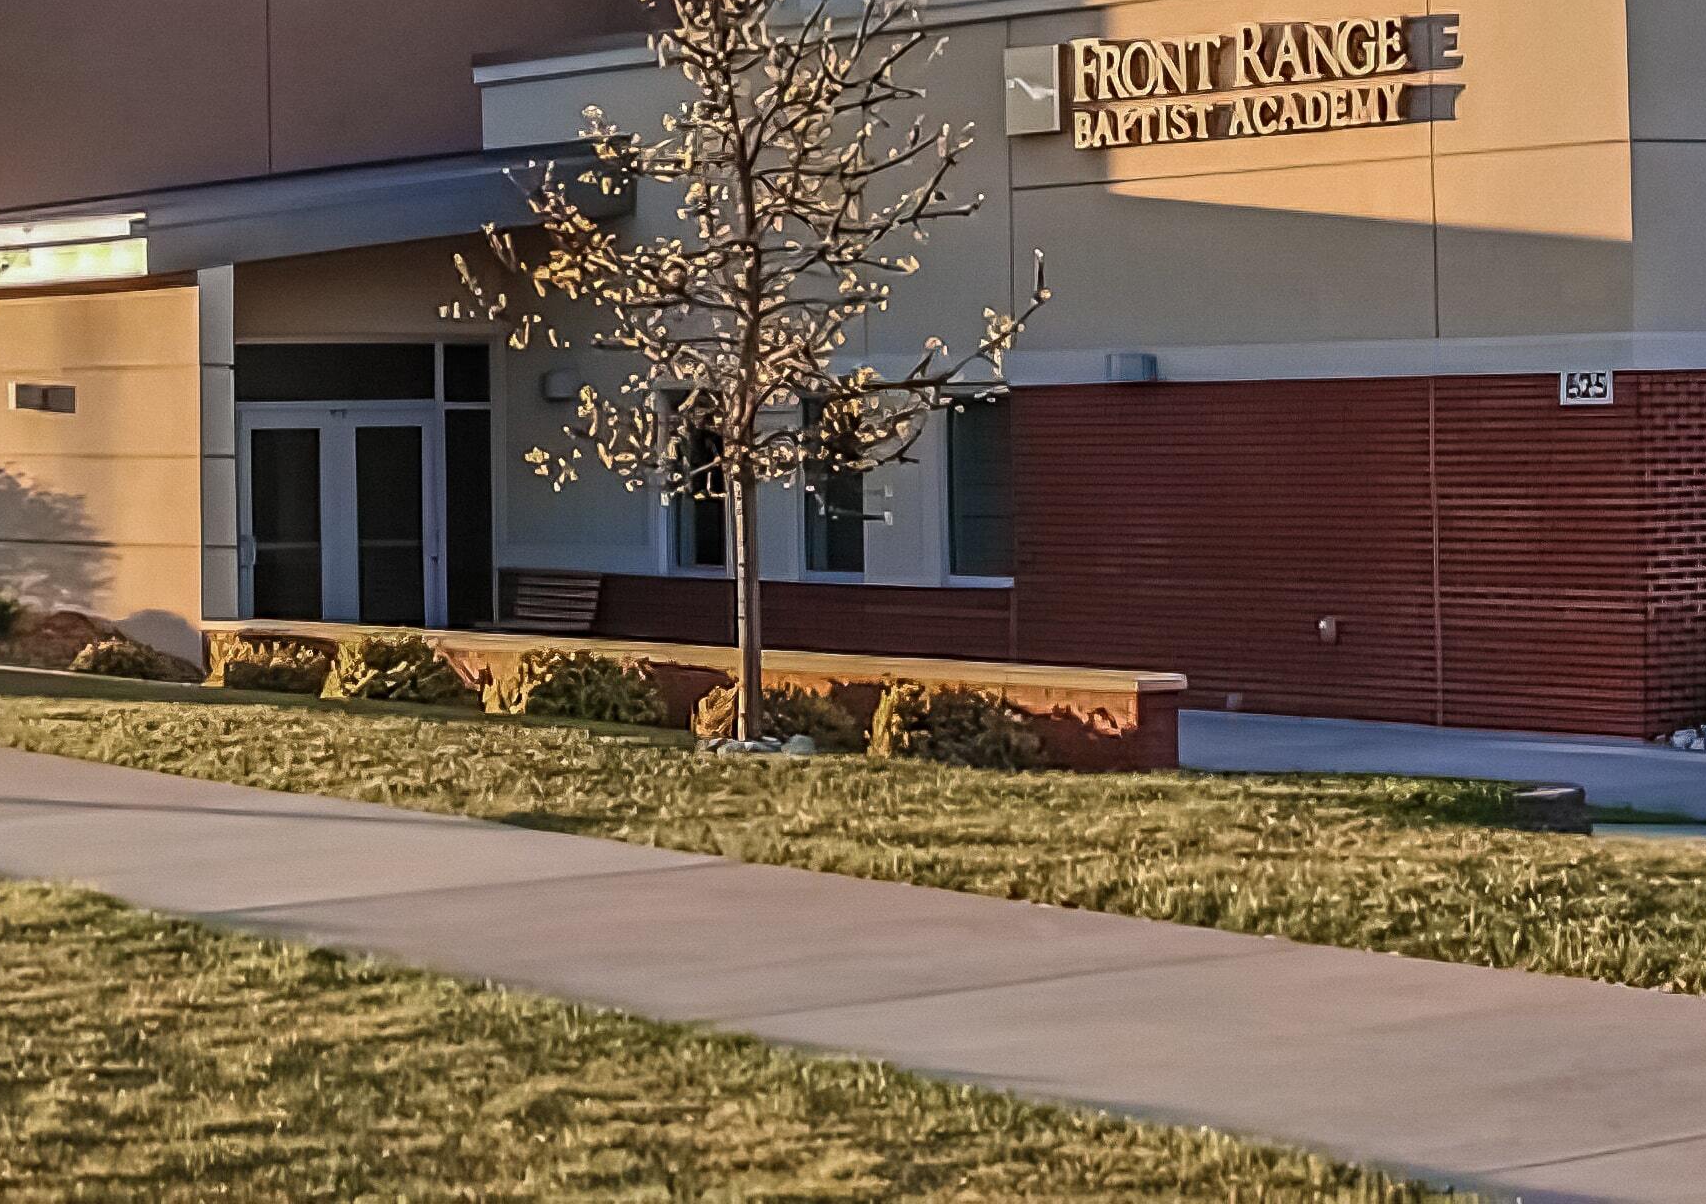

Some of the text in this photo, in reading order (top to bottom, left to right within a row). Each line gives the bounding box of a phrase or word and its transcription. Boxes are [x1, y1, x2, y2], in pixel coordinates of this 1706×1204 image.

[1071, 15, 1408, 103] FRONT RANGE
[1073, 83, 1404, 150] BAPTIST ACADEMY
